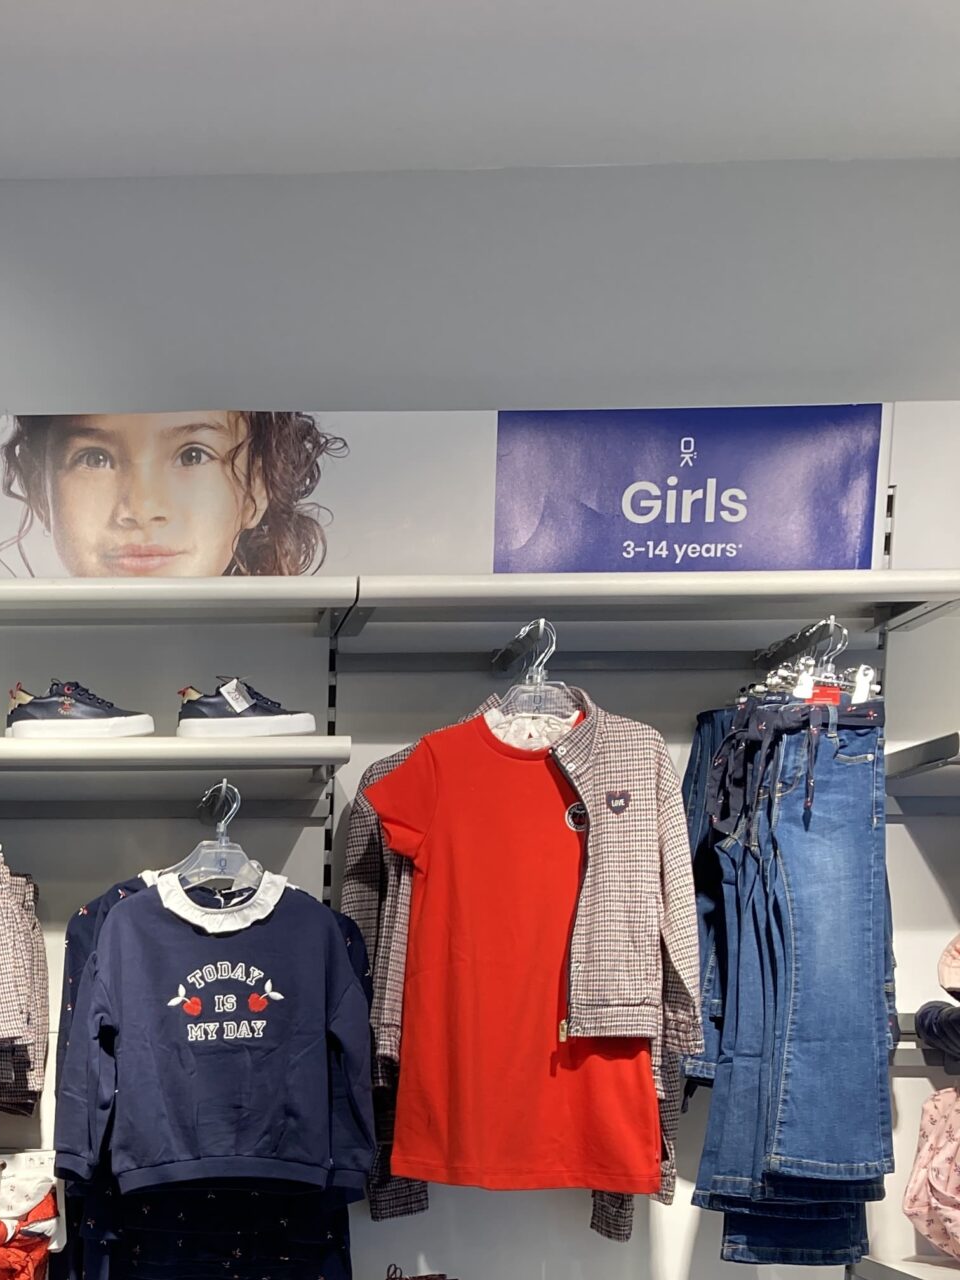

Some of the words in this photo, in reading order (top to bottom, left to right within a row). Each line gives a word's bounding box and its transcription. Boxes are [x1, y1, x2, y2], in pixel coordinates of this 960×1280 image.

[621, 476, 748, 524] Girls
[622, 540, 669, 559] 3-14
[186, 961, 264, 989] TODAY
[214, 994, 237, 1013] IS
[187, 1022, 220, 1041] MY
[223, 1020, 267, 1039] DAY
